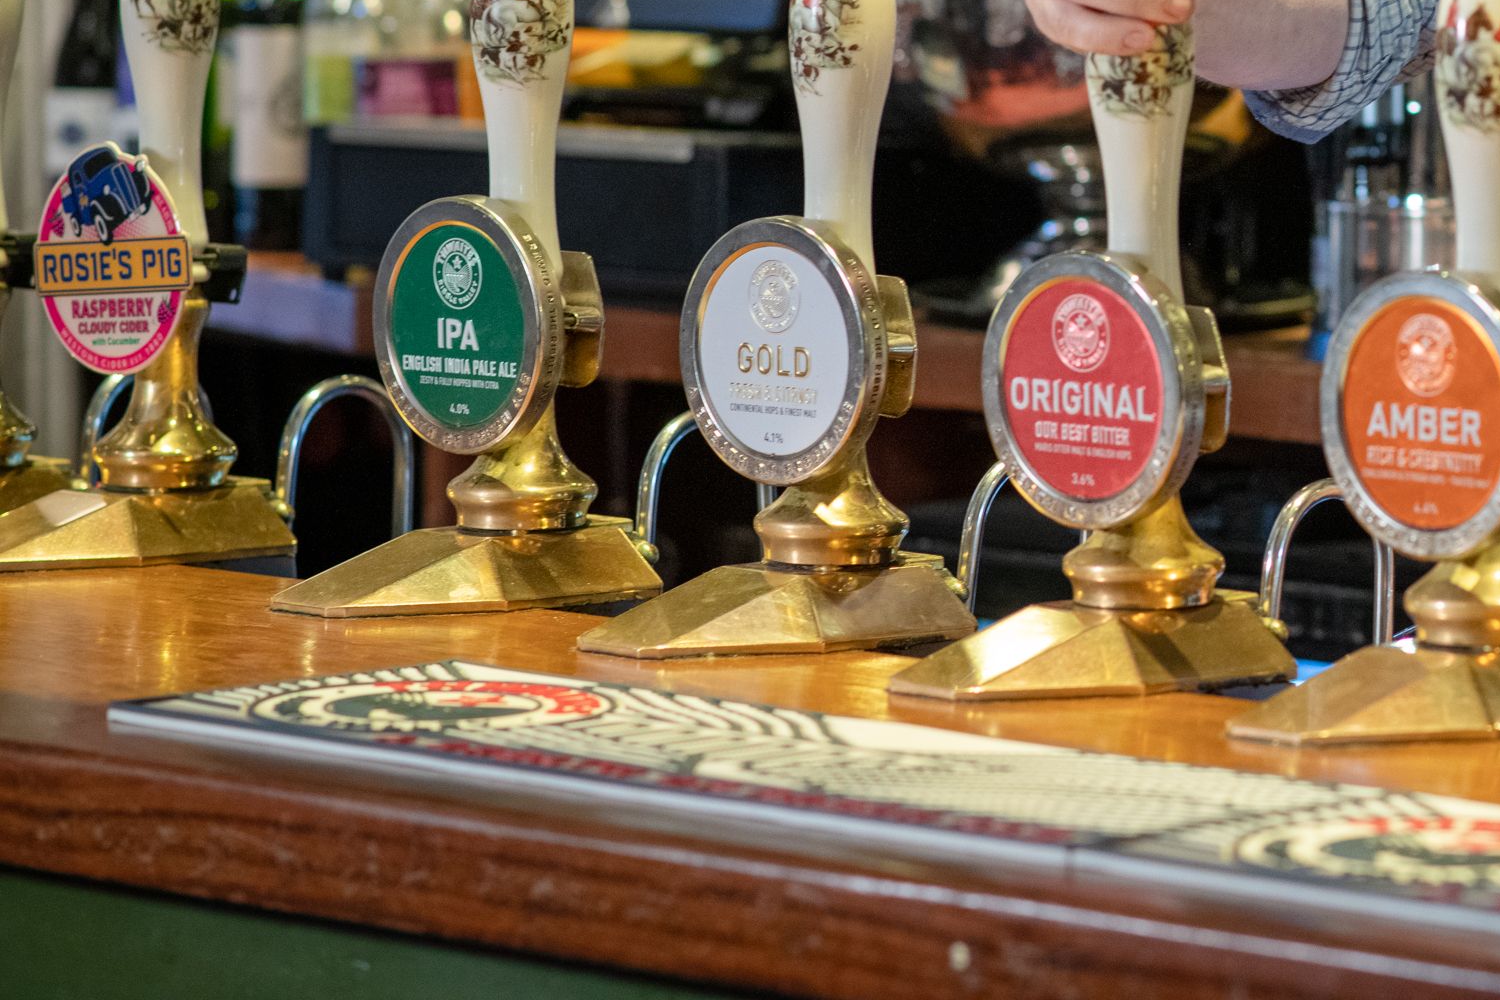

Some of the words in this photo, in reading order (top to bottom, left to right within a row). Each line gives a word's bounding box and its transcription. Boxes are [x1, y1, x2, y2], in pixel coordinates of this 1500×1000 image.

[71, 297, 154, 319] RASPBERRY
[78, 321, 117, 335] CLOUDY
[119, 320, 149, 334] CIDER
[437, 317, 480, 351] IPA
[402, 354, 443, 373] ENGLISH
[444, 357, 471, 375] INDIA
[472, 359, 497, 377] PALE
[498, 361, 517, 379] ALE
[737, 342, 810, 378] GOLD
[1010, 376, 1157, 422] ORIGINAL
[1034, 420, 1058, 440] OUR
[1061, 422, 1090, 442] BEST
[1091, 425, 1131, 446] BITTER
[1366, 400, 1482, 447] AMBER
